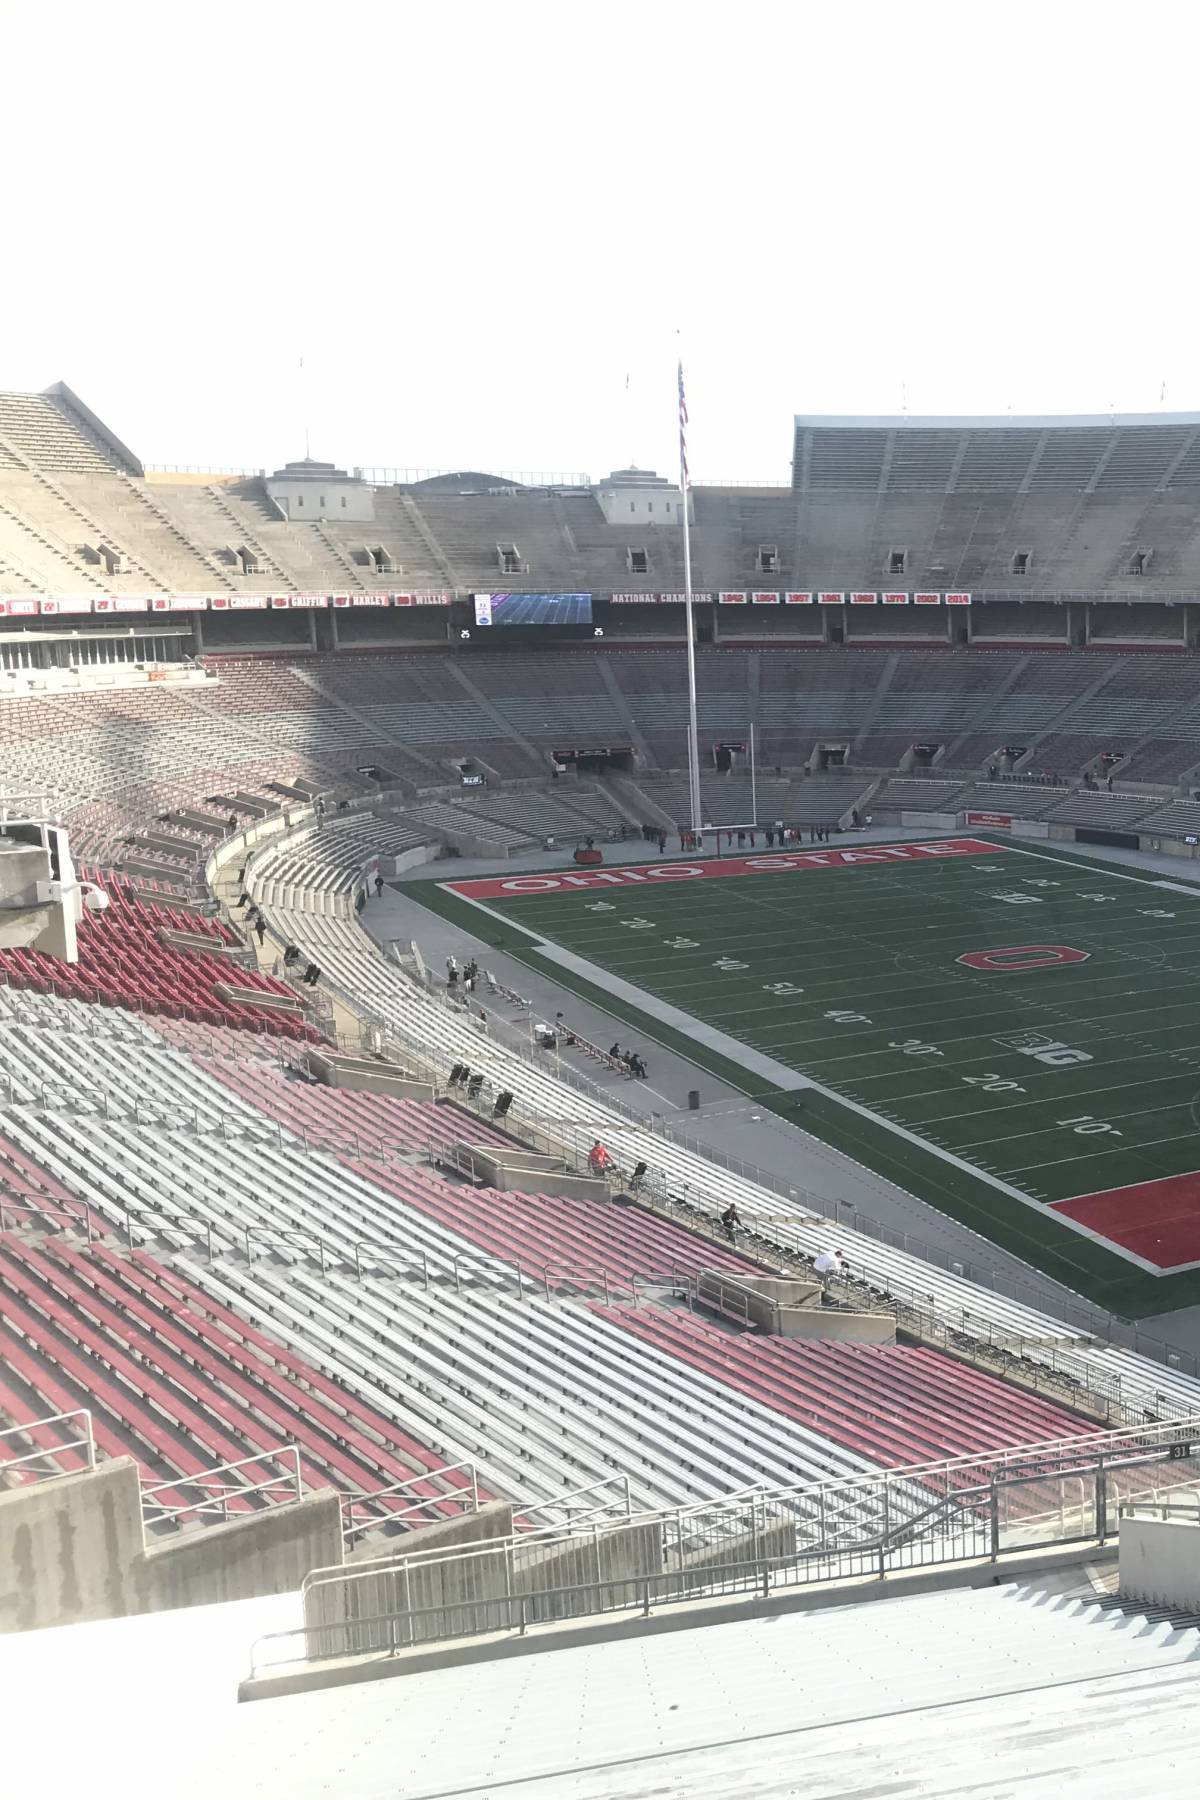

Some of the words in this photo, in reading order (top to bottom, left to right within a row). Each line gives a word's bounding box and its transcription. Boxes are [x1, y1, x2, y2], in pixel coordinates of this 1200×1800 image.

[291, 595, 327, 607] GRIFFIN
[352, 595, 386, 606] HARLEY
[415, 594, 447, 605] WILLIS
[612, 593, 656, 603] NATIONAL
[661, 593, 712, 603] CHAMIONS
[499, 866, 705, 891] OHIO
[744, 843, 968, 870] STATE
[584, 901, 617, 911] 10
[620, 917, 656, 929] 20
[664, 936, 700, 949] 30
[712, 956, 750, 971] 40
[762, 982, 804, 995] 50
[824, 1010, 866, 1023] 40
[887, 1039, 938, 1055] 30
[961, 1073, 1018, 1092] 20
[1055, 1115, 1112, 1134] 10
